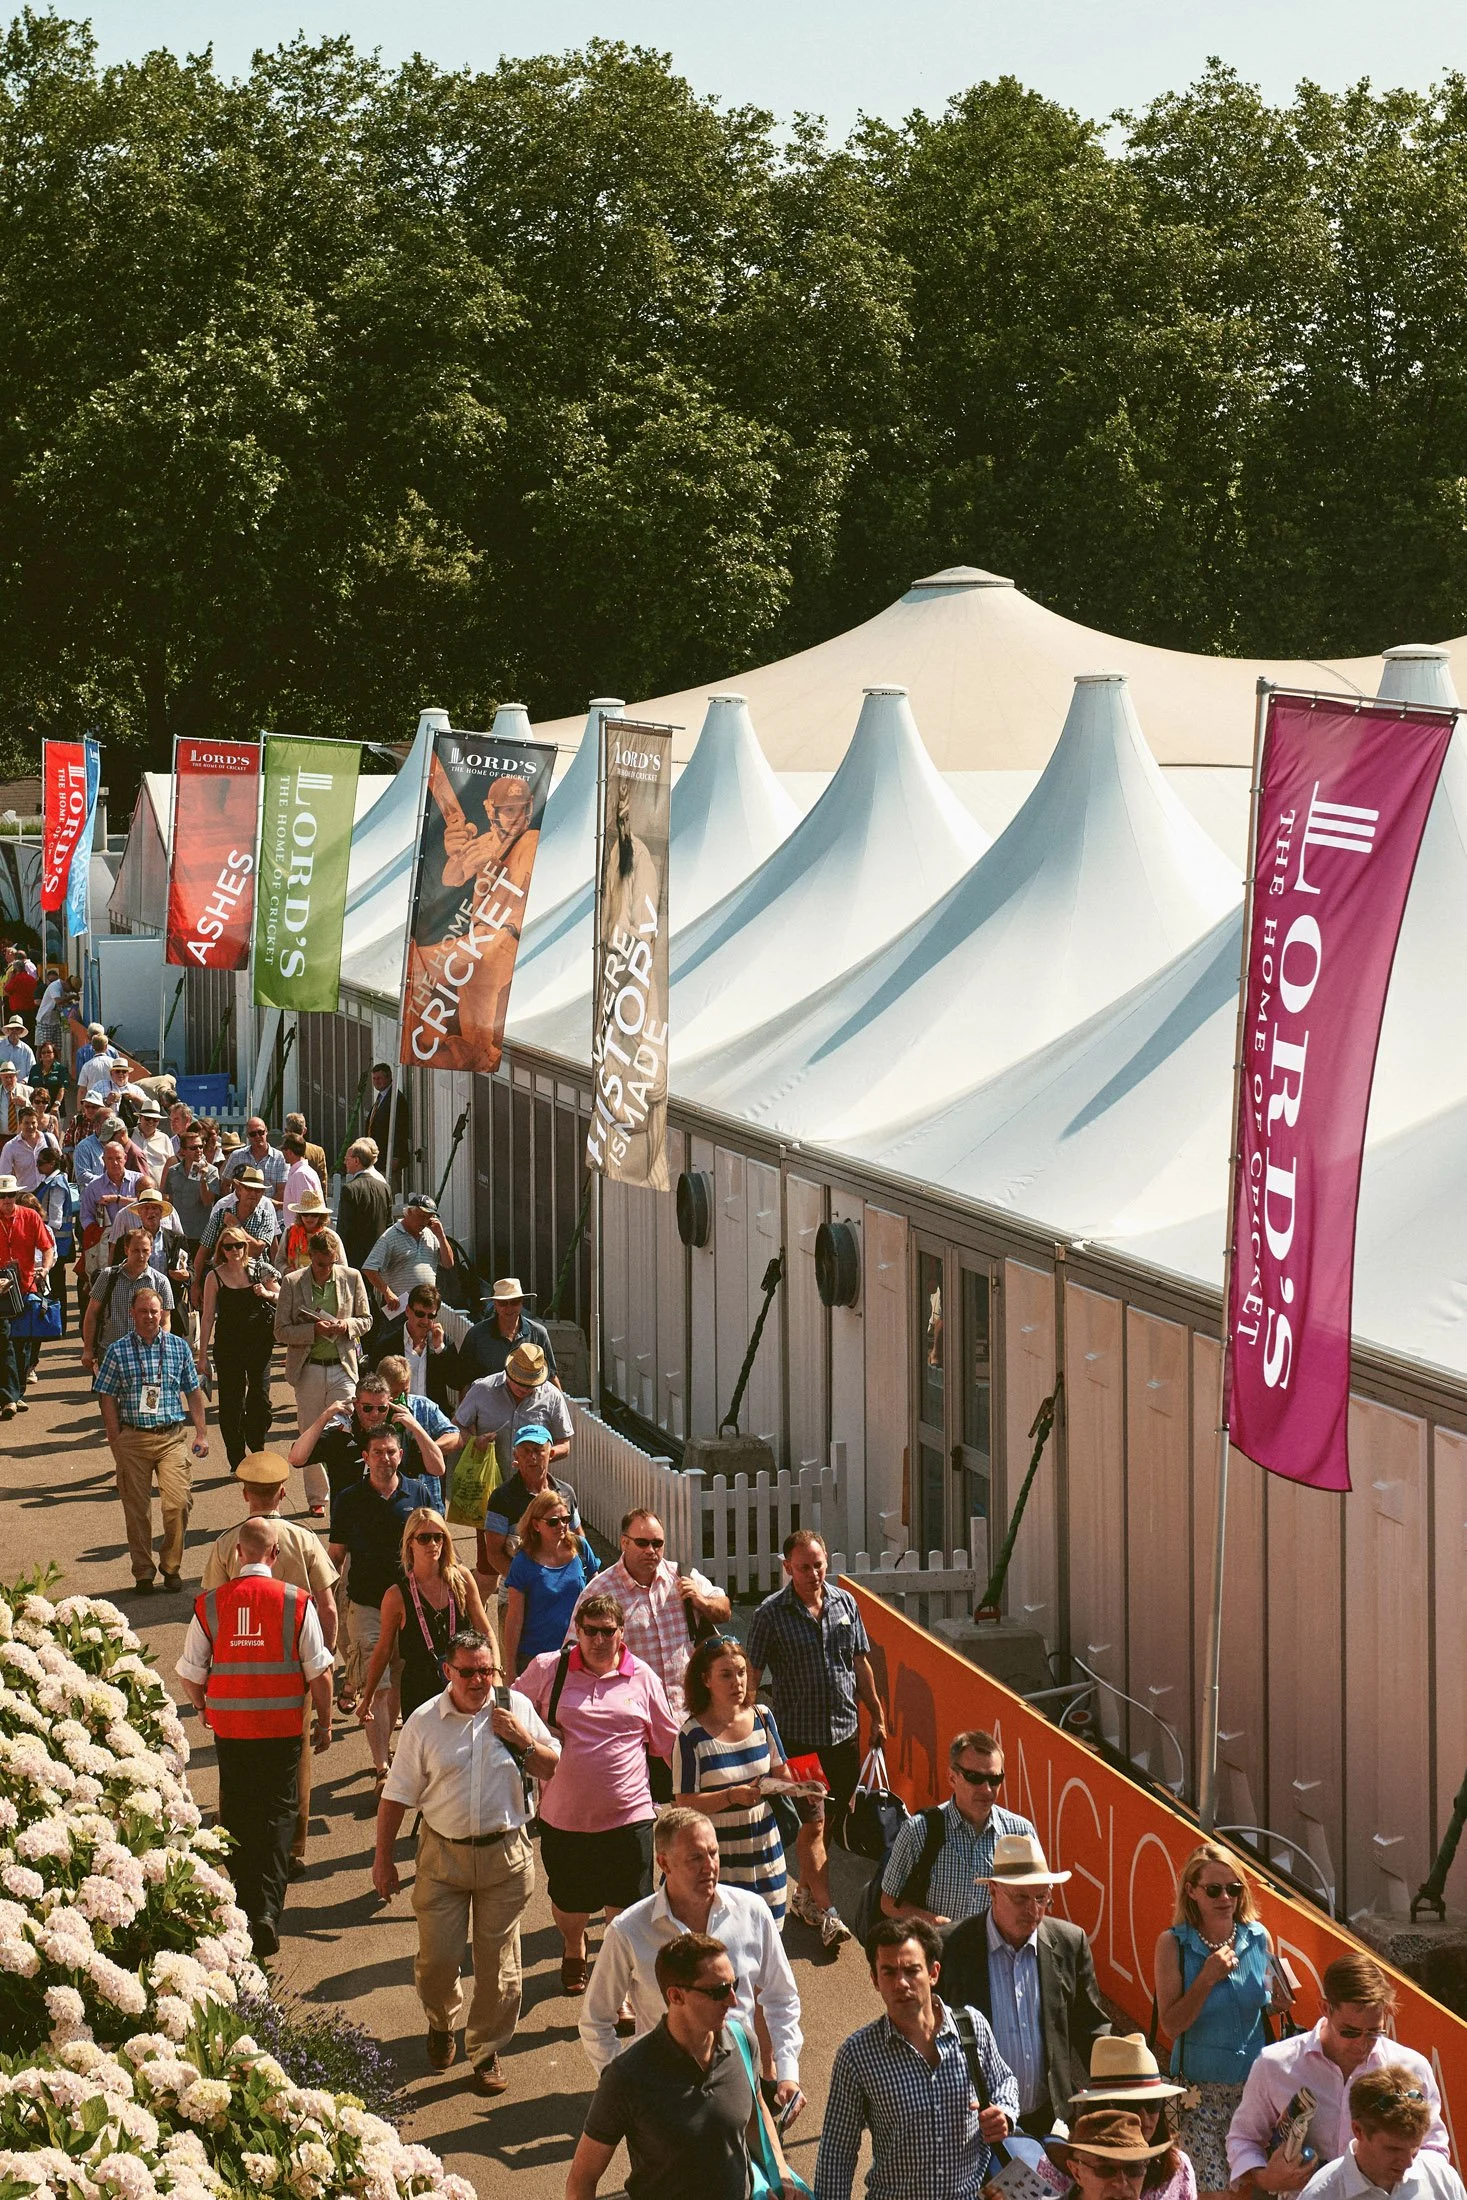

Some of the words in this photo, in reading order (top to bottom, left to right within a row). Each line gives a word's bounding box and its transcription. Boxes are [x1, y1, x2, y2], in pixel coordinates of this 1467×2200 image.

[58, 768, 66, 788] THE
[189, 749, 250, 766] LORD'S
[448, 747, 537, 774] LORD'S
[466, 767, 487, 776] HOME
[489, 770, 499, 778] OF
[501, 772, 531, 782] CRICKET
[59, 792, 67, 823] HOME
[278, 775, 291, 807] THE
[45, 761, 86, 893] LORD'S
[275, 813, 288, 862] HOME
[1269, 808, 1297, 896] THE
[272, 867, 283, 890] OF
[279, 765, 334, 979] LORD'S
[187, 849, 254, 966] ASHES
[264, 895, 280, 966] CRICKET
[408, 970, 437, 1017] THE
[428, 897, 475, 972] HOME
[473, 859, 501, 898] OF
[411, 866, 525, 1061] CRICKET
[1254, 916, 1278, 1052] HOME
[613, 1012, 669, 1144] MADE
[1253, 1072, 1263, 1133] OF
[1263, 781, 1380, 1391] LORD'S
[608, 1136, 627, 1169] IS
[230, 1639, 265, 1647] SUPERVISOR
